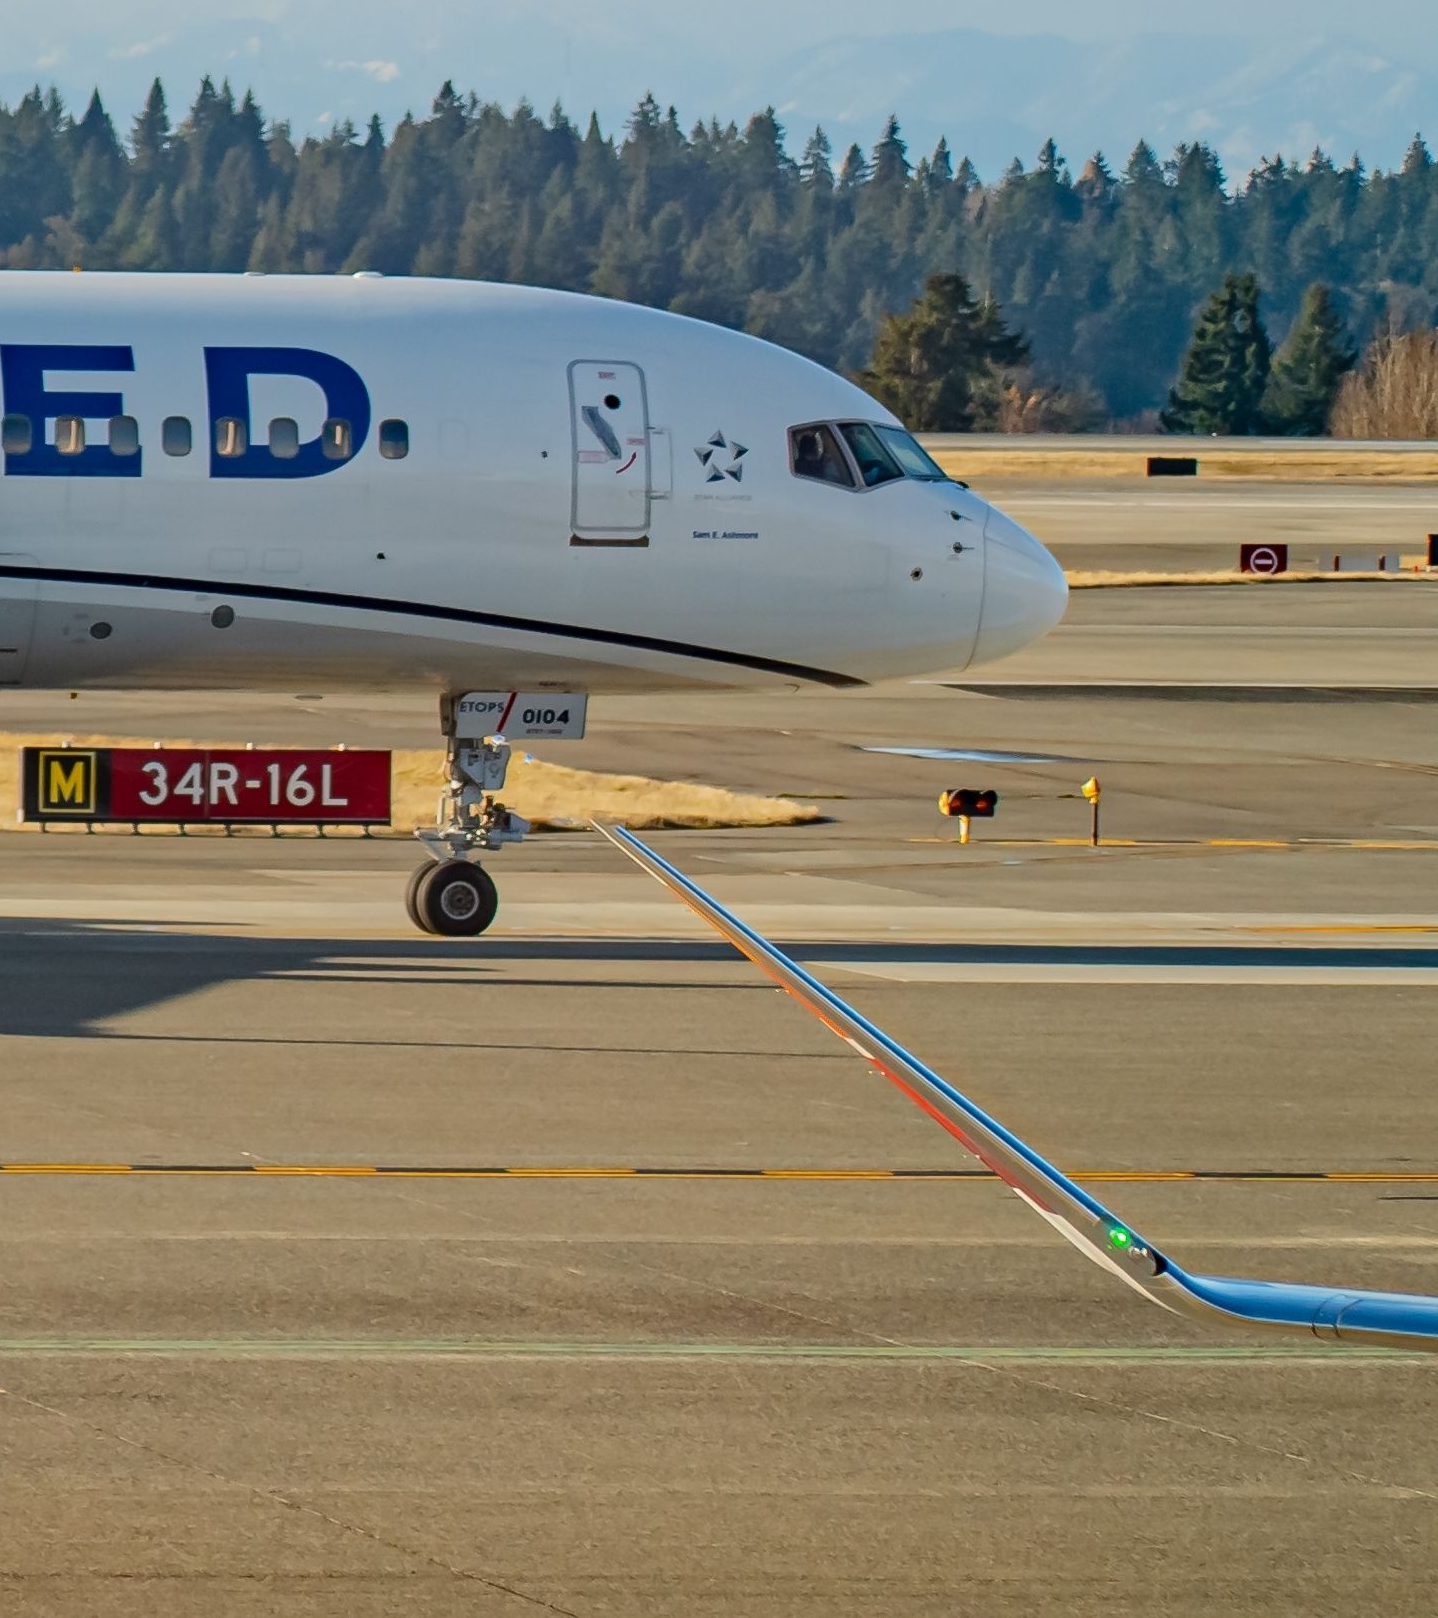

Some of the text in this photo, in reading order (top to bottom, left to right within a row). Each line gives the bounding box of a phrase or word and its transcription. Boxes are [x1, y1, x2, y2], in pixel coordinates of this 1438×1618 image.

[459, 700, 505, 713] ETOPS
[522, 708, 570, 725] 0104
[49, 760, 84, 804] M
[138, 761, 348, 807] 34R-16L
